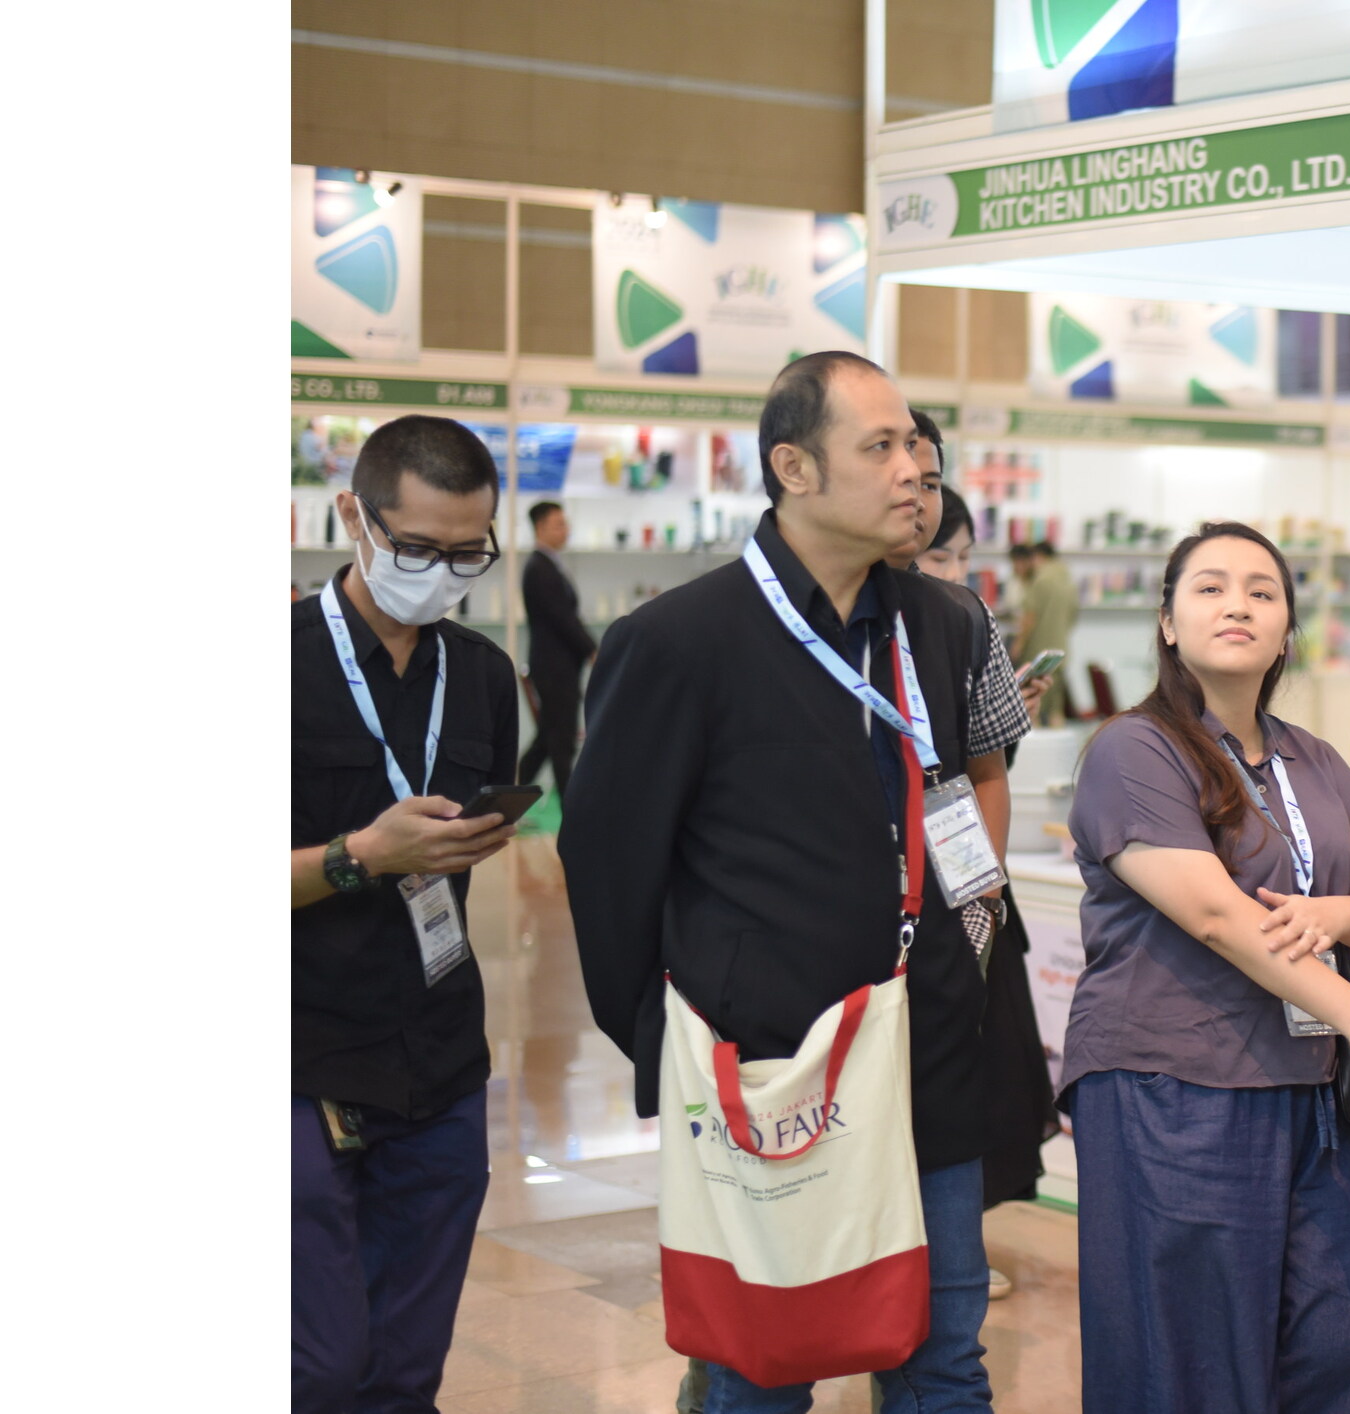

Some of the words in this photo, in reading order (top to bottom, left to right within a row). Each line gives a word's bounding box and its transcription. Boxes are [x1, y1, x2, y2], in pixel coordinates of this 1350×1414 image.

[978, 159, 1067, 199] JINHUA
[1071, 138, 1208, 187] LINGHANG
[979, 191, 1085, 231] KITCHEN
[1089, 171, 1221, 217] INDUSTRY
[1226, 165, 1284, 199] CO.,
[344, 379, 383, 401] LTD.
[776, 1102, 847, 1149] FAIR
